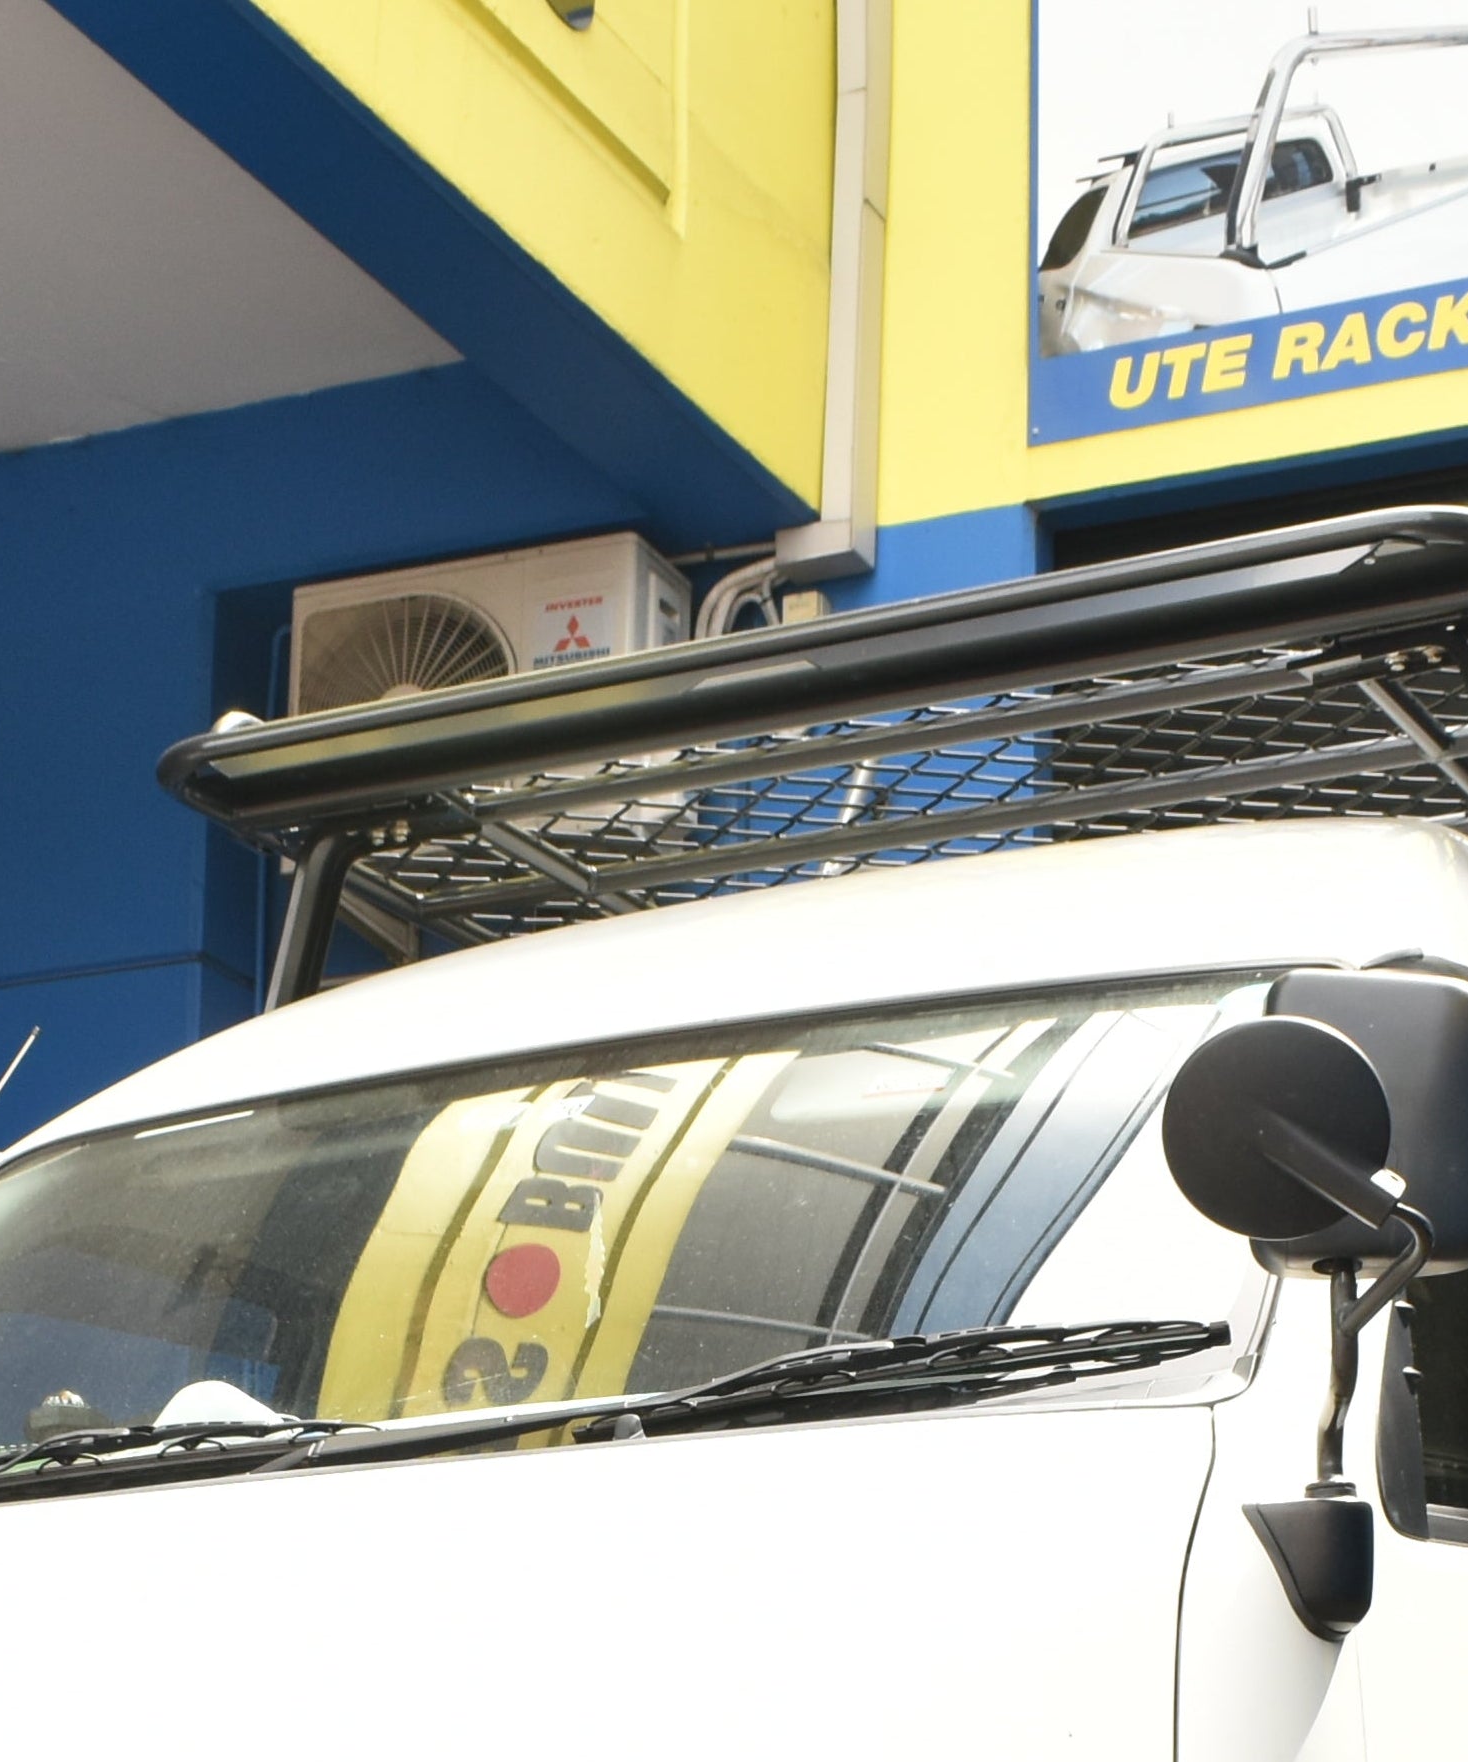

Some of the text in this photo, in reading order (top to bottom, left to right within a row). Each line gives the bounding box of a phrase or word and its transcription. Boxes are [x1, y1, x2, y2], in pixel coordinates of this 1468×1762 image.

[1108, 334, 1254, 409] UTE
[544, 595, 604, 614] INVERTER
[533, 646, 611, 666] MITSUBISHI
